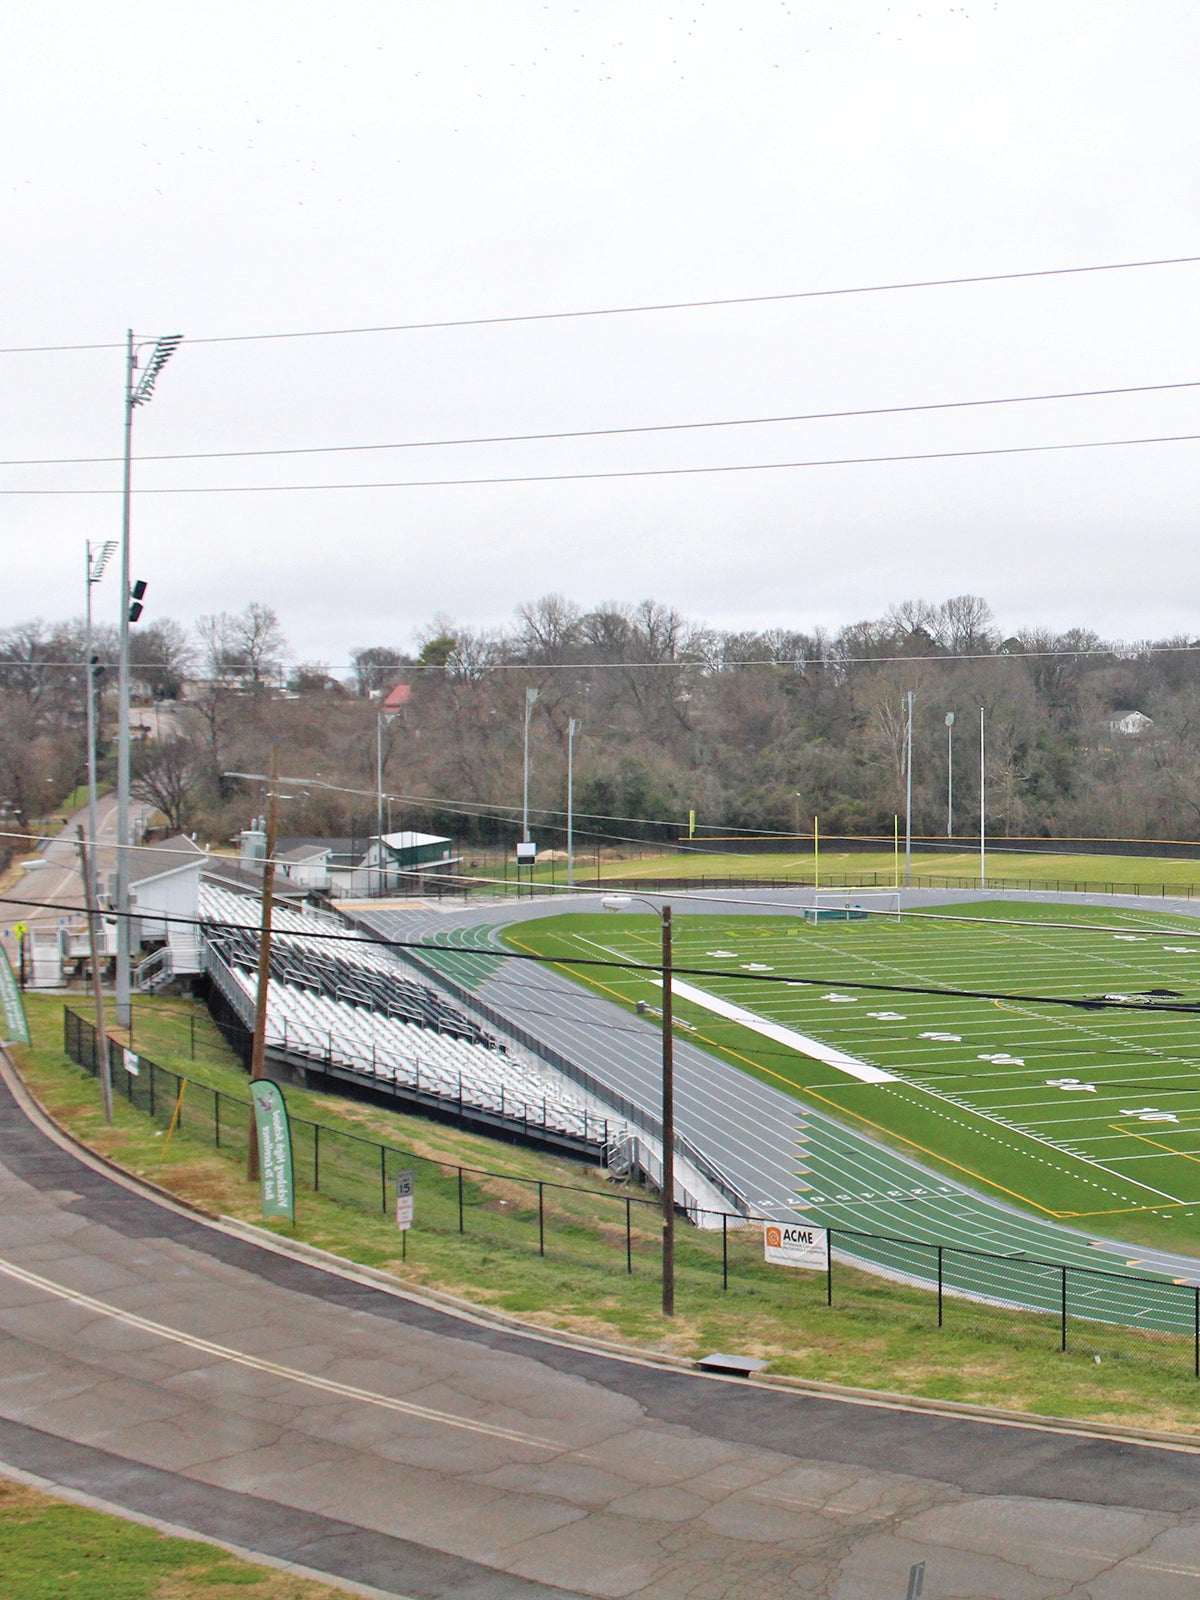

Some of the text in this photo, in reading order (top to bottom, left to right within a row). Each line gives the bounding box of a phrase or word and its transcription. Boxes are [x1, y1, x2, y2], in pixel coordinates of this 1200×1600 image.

[1119, 1107, 1176, 1121] 10
[399, 1183, 411, 1194] 15
[783, 1228, 813, 1244] ACME
